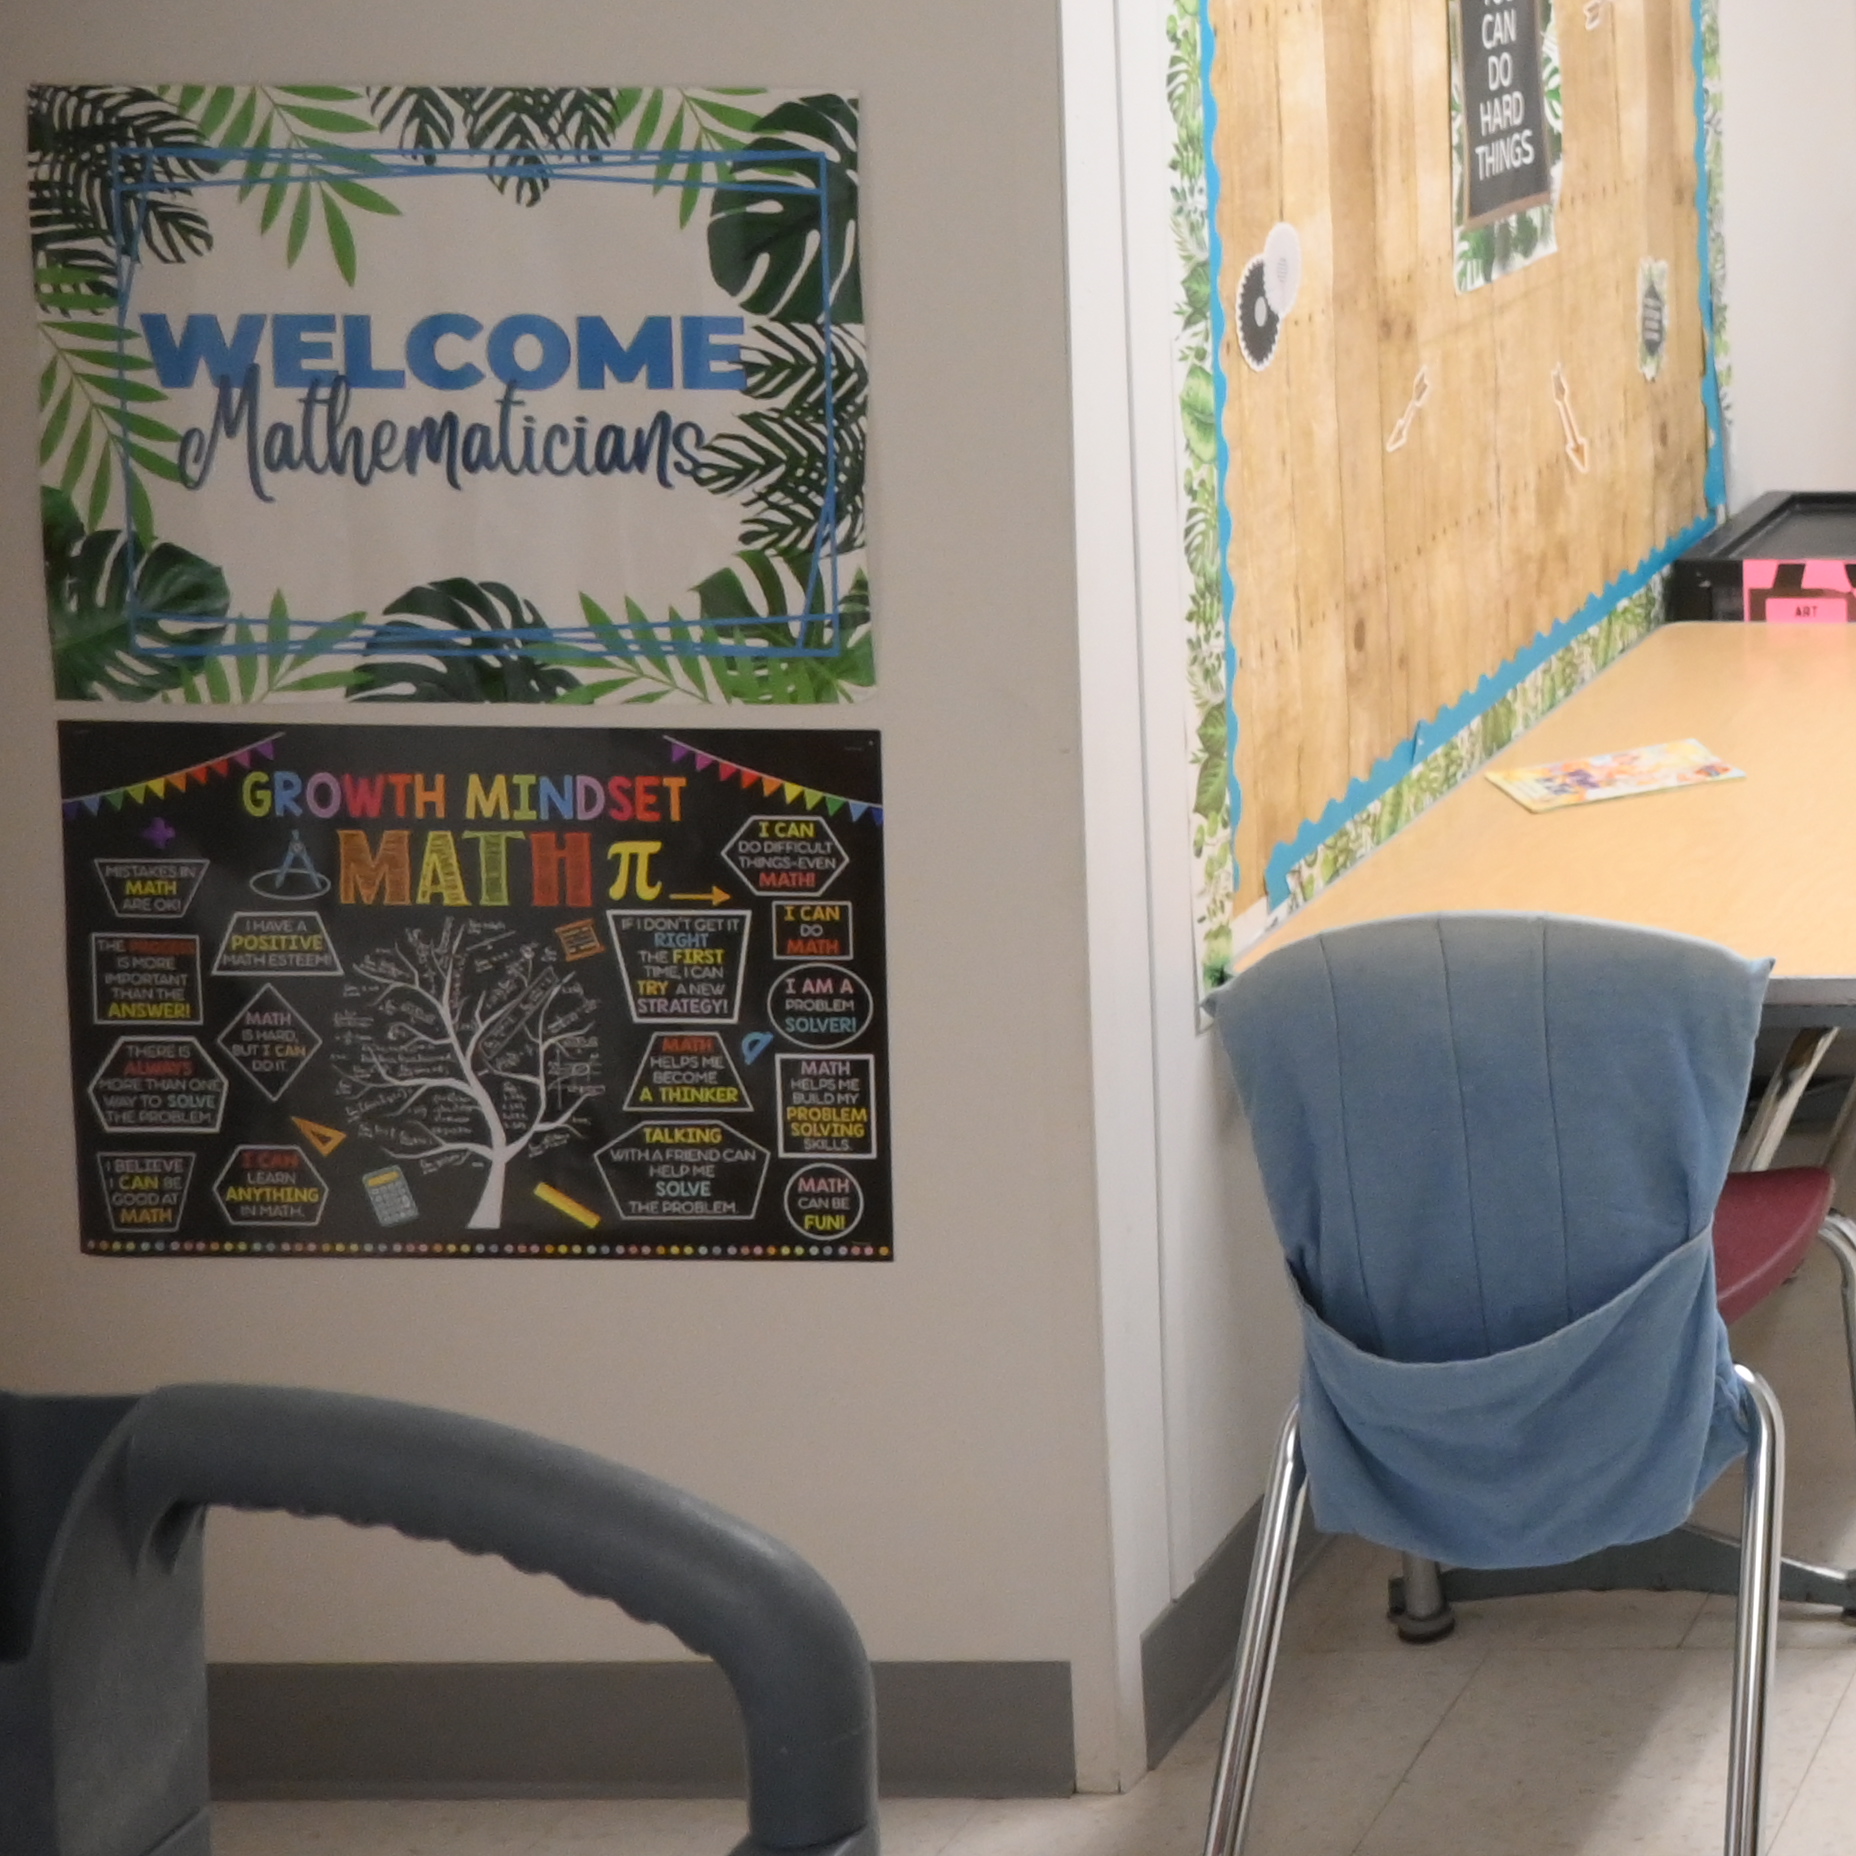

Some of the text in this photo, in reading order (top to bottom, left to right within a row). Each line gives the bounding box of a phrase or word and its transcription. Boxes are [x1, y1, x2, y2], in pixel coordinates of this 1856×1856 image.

[1482, 9, 1517, 50] CAN
[1488, 52, 1513, 91] DO
[1479, 91, 1525, 136] HARD
[1475, 129, 1535, 181] THINGS
[139, 312, 748, 393] WELCOME
[177, 364, 710, 505] Mathematicians
[1795, 605, 1818, 618] ART
[242, 770, 687, 823] GROWTH MINDSET
[758, 821, 815, 838] I CAN
[738, 840, 832, 854] DO DIFFICULT
[105, 865, 196, 878] MISTAKES IN
[336, 828, 593, 908] MATH
[759, 871, 815, 887] MATH!
[125, 880, 177, 895] MATH
[122, 899, 182, 912] ARE OK!
[784, 905, 840, 921] I CAN
[253, 920, 293, 932] HAVE
[297, 921, 307, 932] A
[622, 918, 637, 931] IF
[643, 917, 690, 931] DON'T
[694, 918, 724, 932] GET
[726, 919, 740, 932] IT
[800, 924, 823, 938] DO
[98, 940, 126, 953] THE
[231, 934, 323, 951] POSITIVE
[654, 932, 709, 948] RIGHT
[786, 939, 840, 955] MATH
[117, 957, 176, 970] IS MORE
[222, 953, 266, 967] MATH
[638, 949, 725, 964] THE FIRST
[104, 973, 188, 986] IMPORTANT
[690, 966, 724, 979] CAN
[637, 980, 726, 996] TRY A NEW
[785, 978, 854, 994] I AM A
[111, 987, 185, 1001] THAN THE
[107, 1003, 191, 1019] ANSWER!
[637, 998, 728, 1015] STRATEGY!
[785, 999, 854, 1012] PROBLEM
[246, 1011, 291, 1026] MATH
[785, 1017, 857, 1033] SOLVER!
[242, 1029, 253, 1042] IS
[126, 1045, 191, 1058] THERE IS
[231, 1045, 307, 1058] BUT I CAN
[663, 1037, 714, 1052] MATH
[252, 1060, 274, 1072] DO
[650, 1056, 725, 1070] HELPS ME
[801, 1060, 850, 1076] MATH
[99, 1078, 223, 1092] MORE THAN ONE
[652, 1071, 718, 1085] BECOME
[791, 1078, 860, 1092] HELPS ME
[103, 1095, 216, 1109] WAY TO SOLVE
[639, 1087, 738, 1102] A THINKER
[793, 1092, 860, 1105] BUILD MY
[106, 1111, 137, 1123] THE
[786, 1106, 868, 1122] PROBLEM
[643, 1127, 722, 1144] TALKING
[790, 1122, 865, 1138] SOLVING
[610, 1148, 756, 1162] WITH A FRIEND CAN
[114, 1158, 184, 1173] BELIEVE
[649, 1165, 715, 1179] HELP ME
[119, 1175, 159, 1190] CAN
[163, 1176, 182, 1190] BE
[247, 1171, 296, 1184] LEARN
[797, 1177, 849, 1193] MATH
[225, 1186, 319, 1203] ANYTHING
[655, 1181, 712, 1197] SOLVE
[111, 1193, 179, 1206] GOOD AT
[629, 1200, 659, 1214] THE
[797, 1197, 850, 1211] CAN BE
[120, 1208, 172, 1224] MATH
[240, 1205, 256, 1217] IN
[803, 1214, 845, 1230] FUN!
